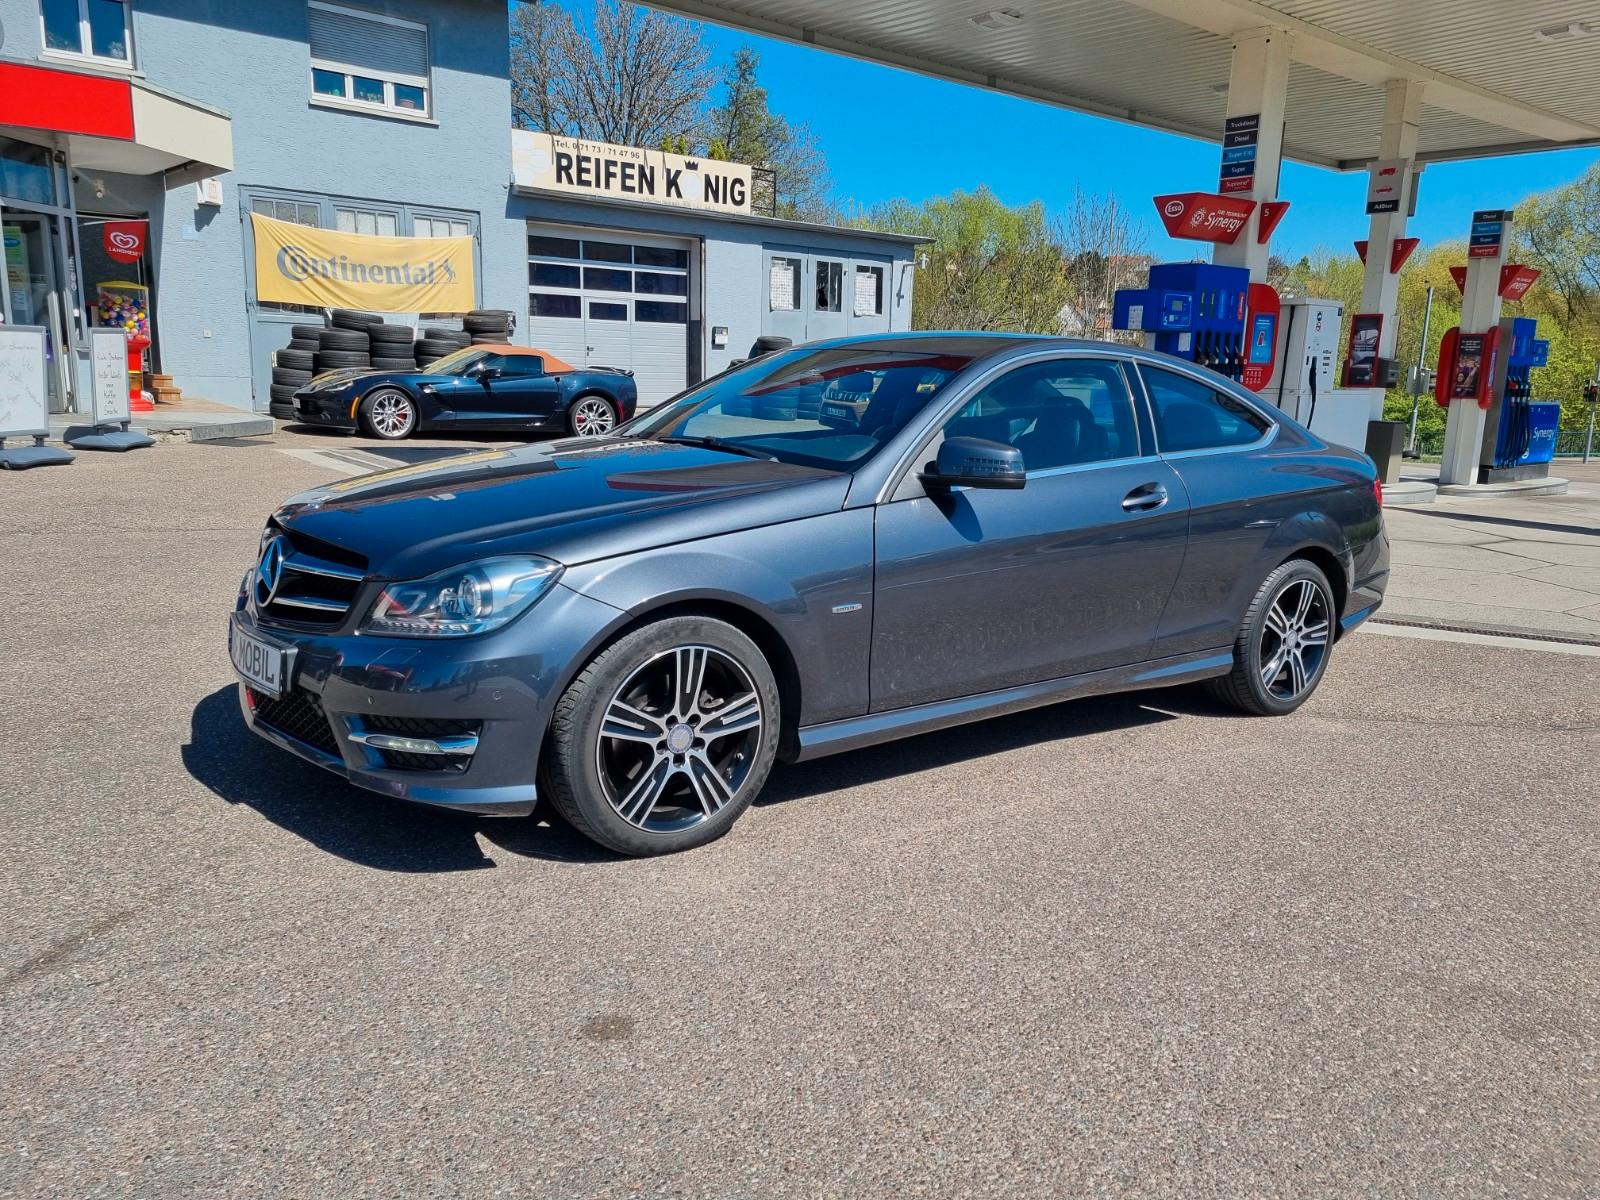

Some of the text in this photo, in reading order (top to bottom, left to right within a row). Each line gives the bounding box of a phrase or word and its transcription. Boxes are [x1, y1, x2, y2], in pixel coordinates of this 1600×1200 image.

[556, 140, 570, 149] Tel.
[555, 151, 746, 207] REIFEN KNIG
[1167, 203, 1182, 212] Esso
[1264, 209, 1270, 217] 5
[1204, 212, 1244, 233] Synergy
[276, 245, 436, 285] Continental
[1532, 426, 1555, 442] Synergy
